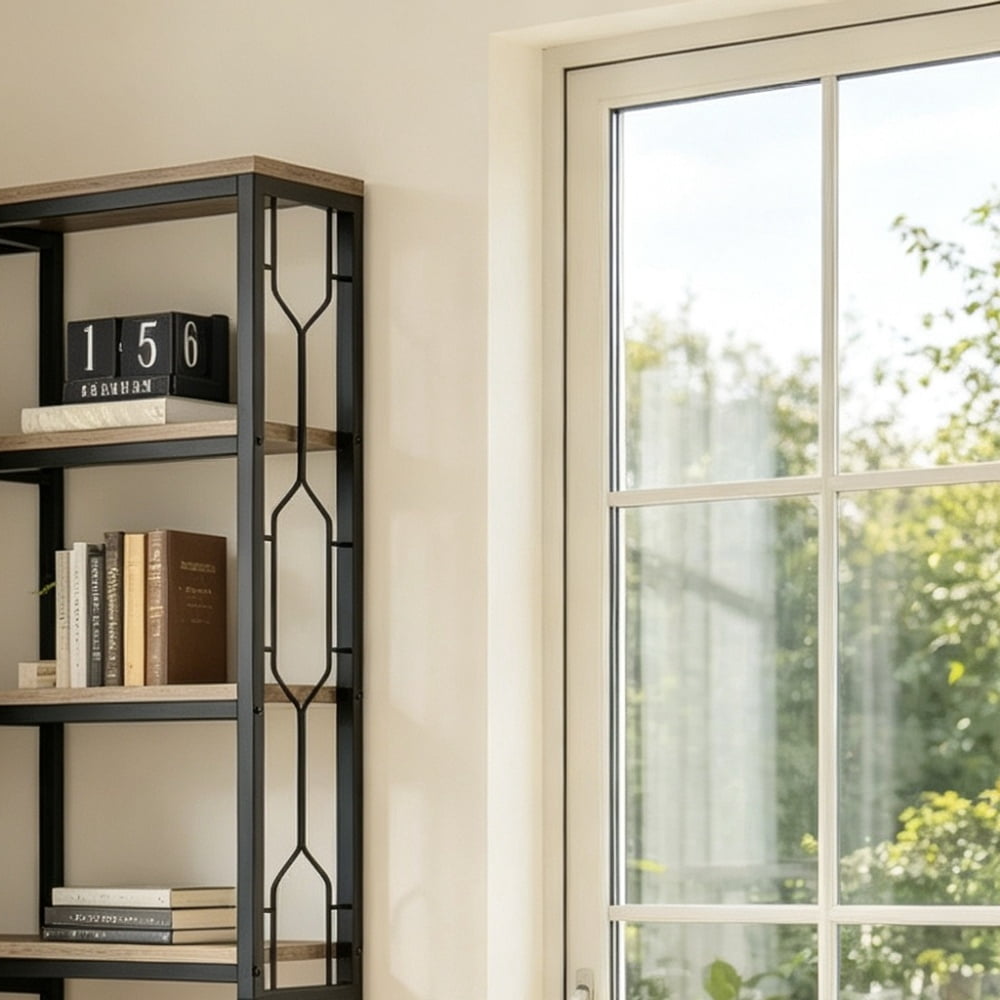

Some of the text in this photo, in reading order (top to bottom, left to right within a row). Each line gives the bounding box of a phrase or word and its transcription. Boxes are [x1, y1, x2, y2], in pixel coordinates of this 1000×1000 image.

[83, 320, 199, 372] 1 5 6
